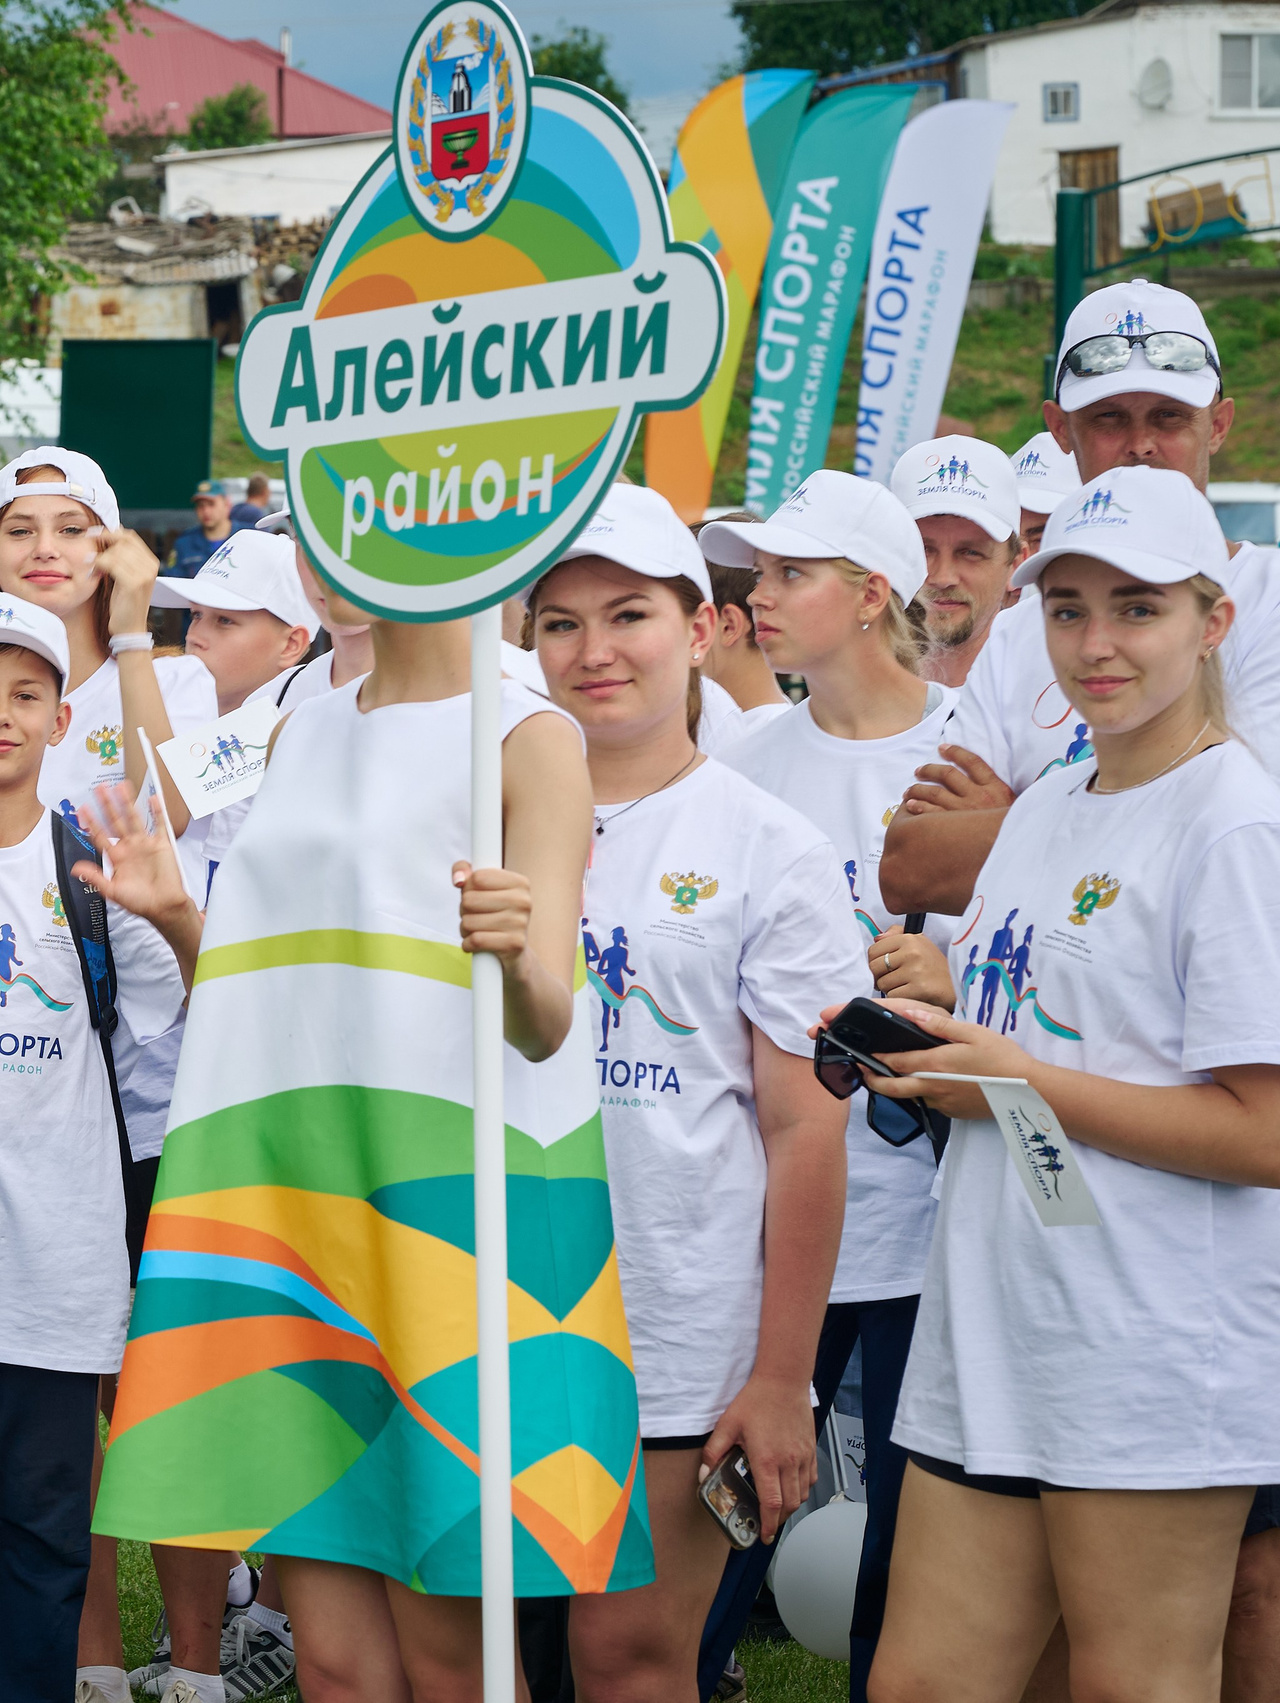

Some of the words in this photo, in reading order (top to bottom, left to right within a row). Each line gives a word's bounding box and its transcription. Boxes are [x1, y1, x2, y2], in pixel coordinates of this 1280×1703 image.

[756, 176, 839, 383] СПОРТА
[862, 205, 929, 388] СПОРТА
[915, 249, 948, 350] МАРАФОН
[270, 271, 670, 428] Алейский
[781, 343, 828, 499] РОССИЙСКИЙ
[816, 225, 856, 339] МАРАФОН
[341, 444, 554, 559] район
[917, 485, 949, 497] ЗЕМЛЯ
[951, 486, 988, 501] СПОРТА
[1090, 516, 1129, 525] СПОРТА
[202, 773, 235, 792] ЗЕМЛЯ
[595, 1058, 681, 1094] ПОРТА
[1008, 1109, 1030, 1149] ЗЕМЛЯ
[1027, 1152, 1052, 1201] СПОРТА
[846, 1437, 866, 1450] ОРТА
